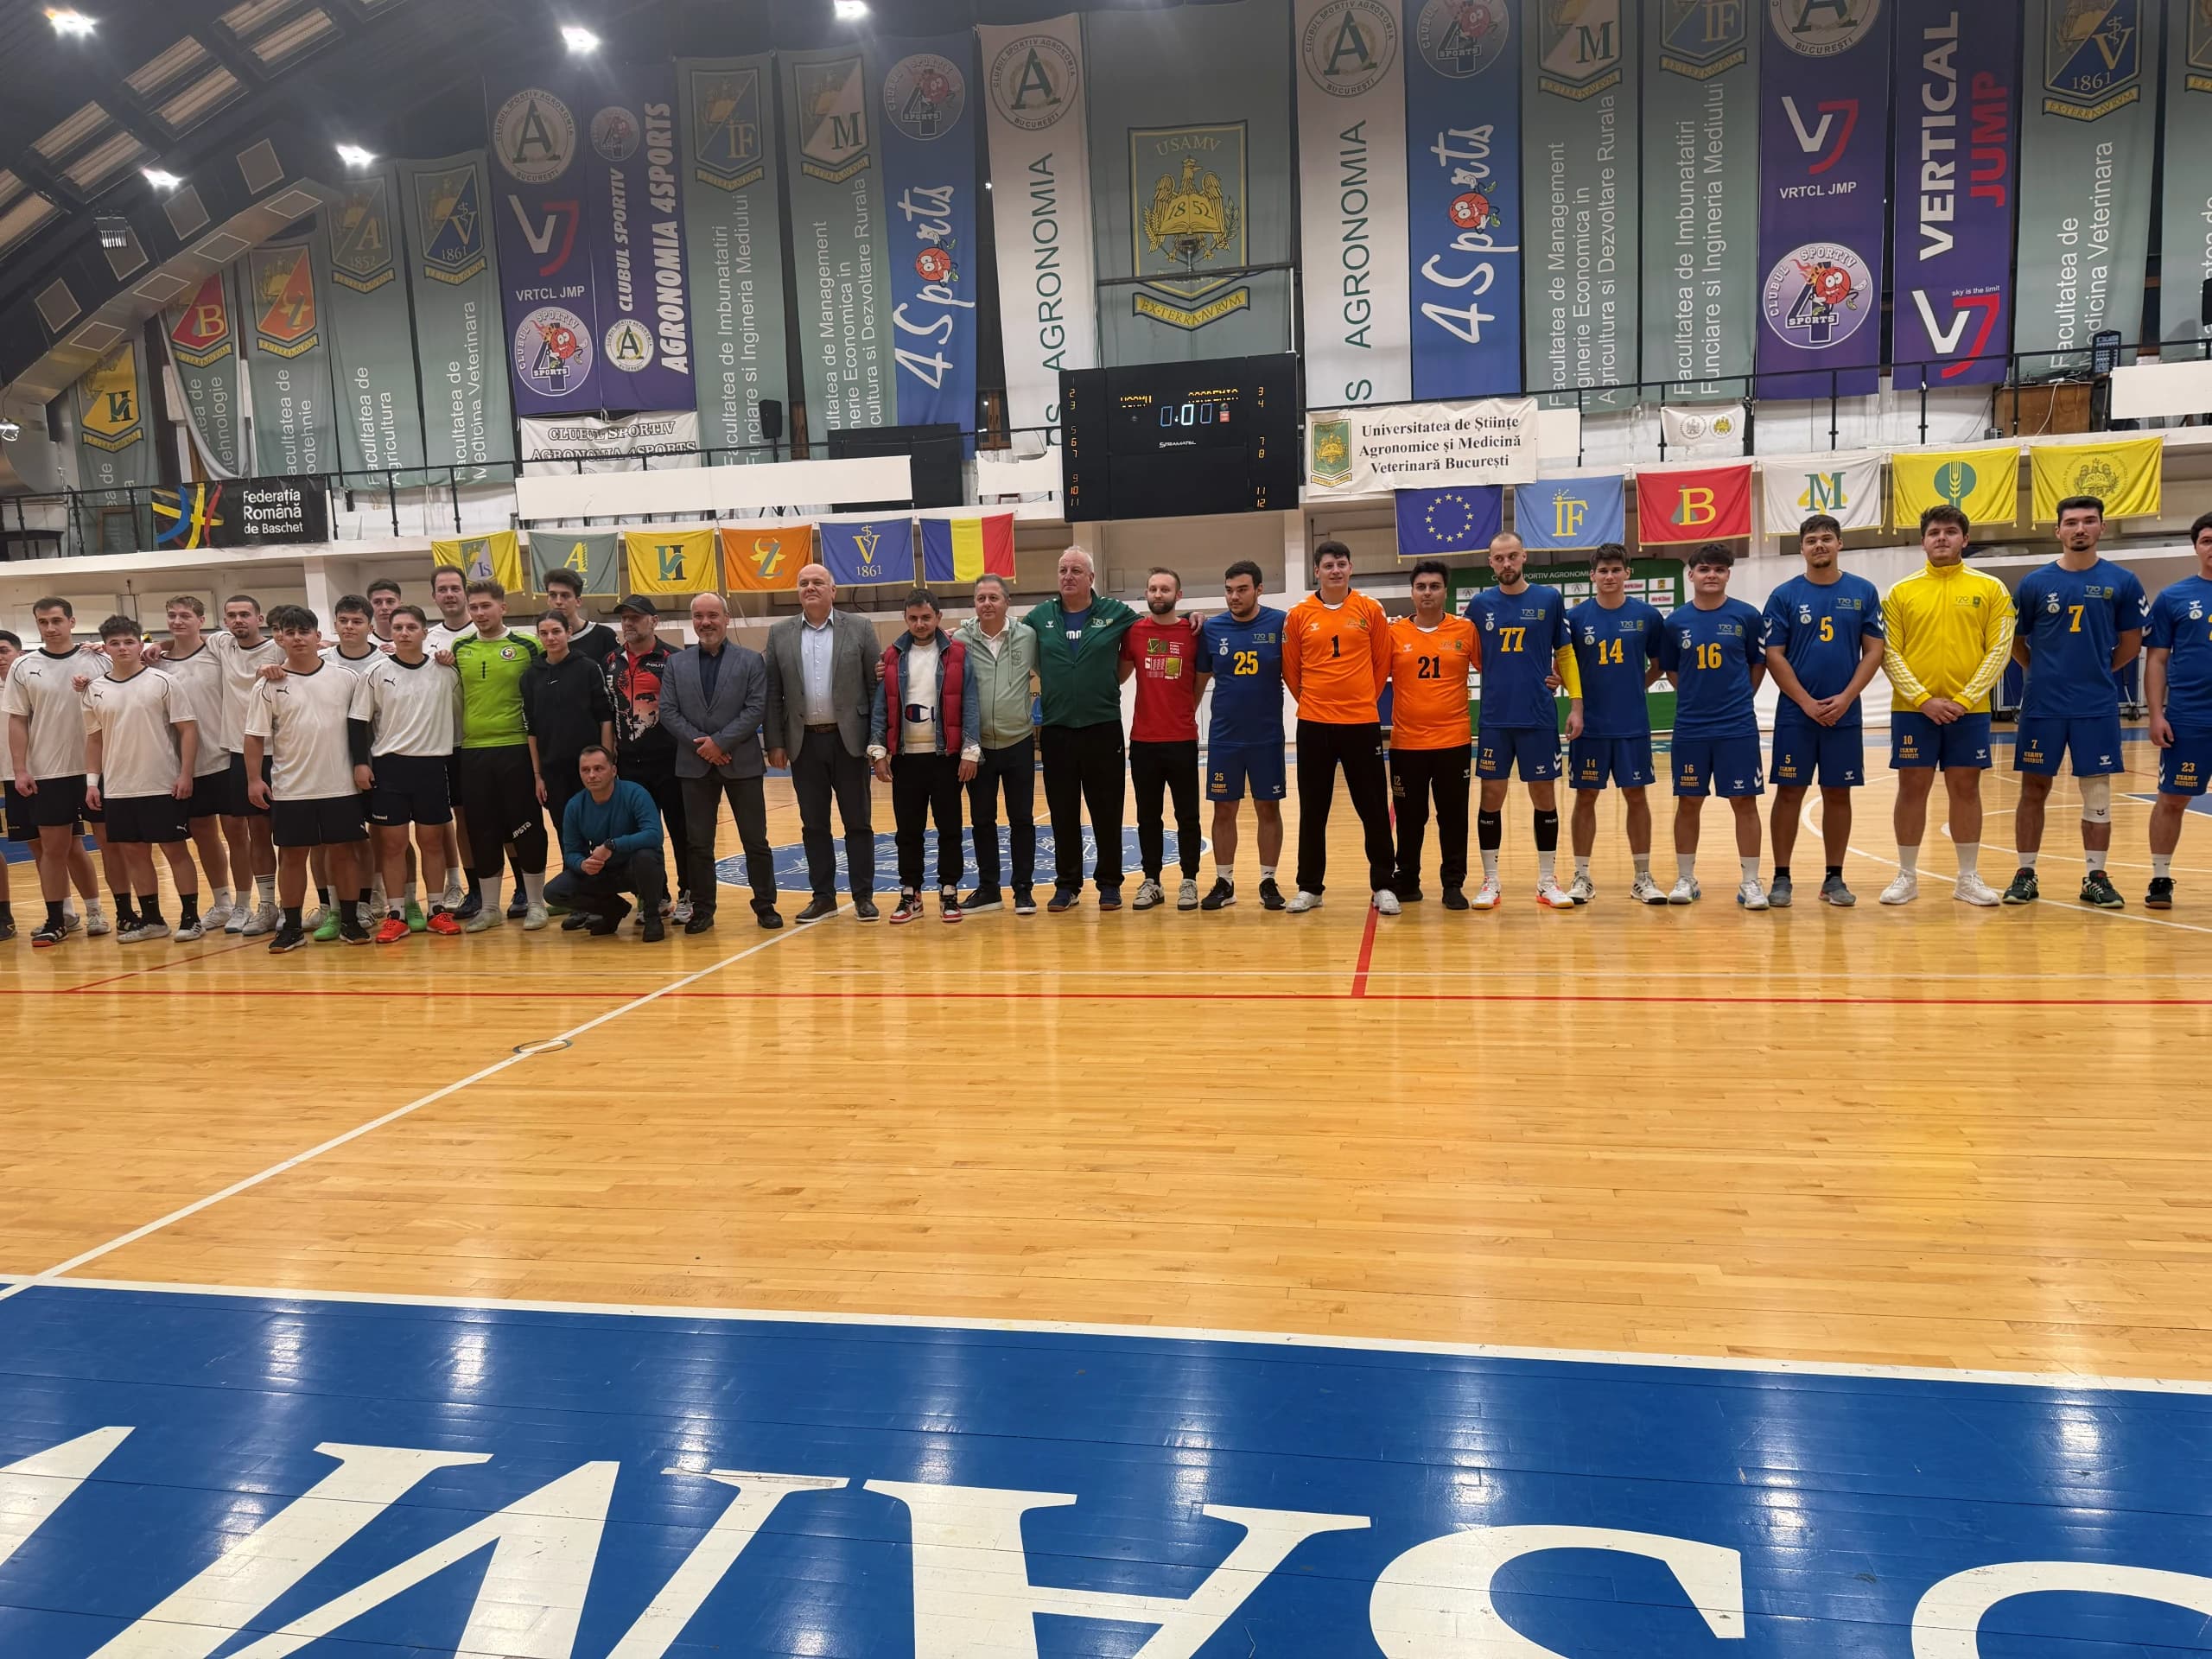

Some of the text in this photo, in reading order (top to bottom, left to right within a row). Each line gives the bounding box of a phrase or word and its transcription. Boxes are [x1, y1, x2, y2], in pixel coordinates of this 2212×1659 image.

[1324, 10, 1377, 76] A
[1575, 20, 1616, 64] M
[2091, 28, 2135, 70] V
[1009, 48, 1062, 110] A
[2072, 71, 2111, 91] 1861
[512, 99, 561, 163] A
[830, 111, 862, 149] M
[1919, 10, 1960, 261] VERTICAL
[1970, 71, 2008, 207] JUMP
[1155, 135, 1221, 156] USAMV
[1572, 187, 1591, 205] in
[1675, 120, 1695, 246] Imbunatatiri
[1779, 181, 1858, 199] VRTCL JMP
[609, 168, 629, 245] SPORTIV
[2088, 140, 2114, 260] Veterinara
[645, 103, 689, 375] AGRONOMIA 4SPORTS
[1339, 119, 1372, 349] AGRONOMIA
[1700, 82, 1726, 394] Funciare si Ingineria Mediului
[442, 245, 467, 262] 1861
[1028, 152, 1068, 372] AGRONOMIA
[1597, 95, 1619, 404] Agricultura si Dezvoltare Rurala
[852, 178, 876, 360] si Dezvoltare Rurala
[1548, 142, 1569, 407] Facultatea de Management
[1573, 210, 1592, 317] Economica
[1674, 253, 1694, 280] de
[516, 286, 585, 302] VRTCL JMP
[616, 249, 633, 312] CLUBUL
[812, 220, 836, 365] de Management
[1768, 246, 1857, 317] CLUBUL SPORTIV
[1985, 284, 2000, 293] limit
[2050, 218, 2079, 369] Facultatea de
[197, 304, 225, 338] B
[733, 194, 761, 467] Funciare si Ingineria Mediului
[836, 261, 859, 381] Economica in
[1789, 315, 1836, 326] SPORTS
[517, 309, 580, 372] CLUBUL SPORTIV
[616, 326, 645, 359] A
[712, 225, 739, 467] Facultatea de Imbunatatiri
[1674, 296, 1694, 395] Facultatea
[276, 370, 290, 391] de
[532, 367, 569, 378] SPORTS
[189, 378, 204, 400] de
[463, 302, 487, 480] Medicina Veterinara
[1258, 386, 1264, 396] 3
[1257, 399, 1264, 408] 4
[354, 367, 380, 485] Facultatea de
[446, 360, 467, 480] Facultatea de
[607, 422, 676, 439] SPORTIV
[1362, 416, 1520, 437] Universitatea de Științe
[380, 392, 402, 486] Agricultura
[1259, 436, 1265, 446] 7
[1359, 435, 1522, 459] Agronomice și Medicină
[1258, 449, 1265, 459] 8
[1370, 454, 1510, 474] Veterinară București
[1256, 499, 1266, 508] 12
[1804, 472, 1847, 512] M
[243, 502, 302, 520] Română
[1552, 499, 1589, 537] IF
[1679, 487, 1716, 526] B
[244, 521, 304, 534] de Baschet
[852, 534, 880, 564] V
[856, 564, 882, 578] 1861
[1819, 616, 1834, 642] 5
[2068, 605, 2085, 632] 7
[1332, 634, 1341, 658] 1
[1499, 626, 1526, 652] 77
[1599, 638, 1624, 665] 14
[1233, 651, 1259, 676] 25
[1417, 656, 1441, 679] 21
[1696, 643, 1722, 670] 16
[1483, 748, 1493, 758] 77
[1903, 735, 1913, 745] 10
[2031, 739, 2037, 749] 7
[1586, 759, 1596, 768] 14
[1684, 764, 1694, 773] 16
[1784, 754, 1791, 764] 5
[2181, 762, 2196, 772] 23
[1214, 772, 1224, 782] 25
